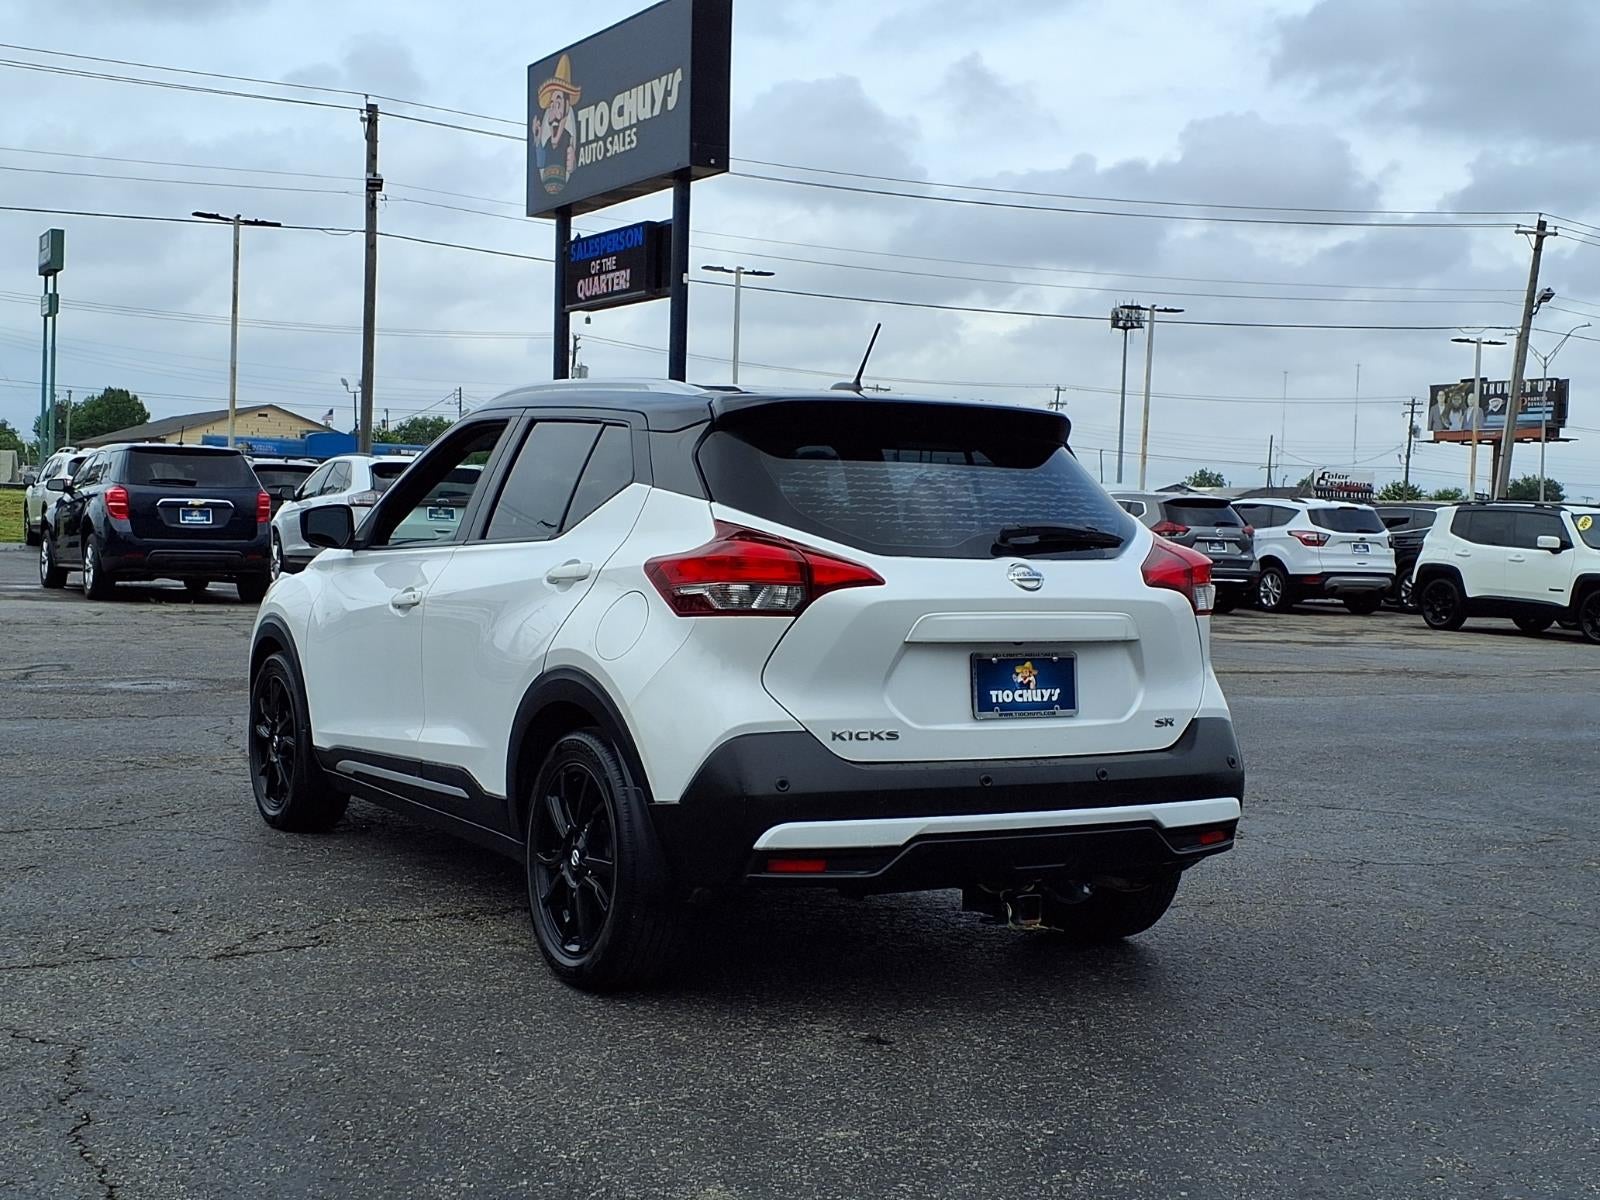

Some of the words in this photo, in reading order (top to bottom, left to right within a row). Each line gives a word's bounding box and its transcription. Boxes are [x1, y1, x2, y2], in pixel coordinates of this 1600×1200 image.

[578, 101, 609, 143] TIO
[611, 67, 682, 130] CHUY'S
[578, 141, 604, 167] AUTO
[606, 128, 637, 157] SALES
[570, 226, 644, 262] SALESPERSON
[590, 260, 600, 274] OF
[602, 256, 617, 272] THE
[577, 269, 631, 300] QUARTER!
[1483, 382, 1531, 395] THUNER
[1537, 380, 1556, 392] UP!
[1316, 477, 1372, 487] Creations
[1321, 471, 1350, 480] Color
[1012, 570, 1042, 578] NISSAN
[990, 690, 1013, 703] TIO
[1014, 688, 1060, 702] CHUY'S
[1154, 717, 1174, 728] SR
[831, 730, 900, 741] KICKS
